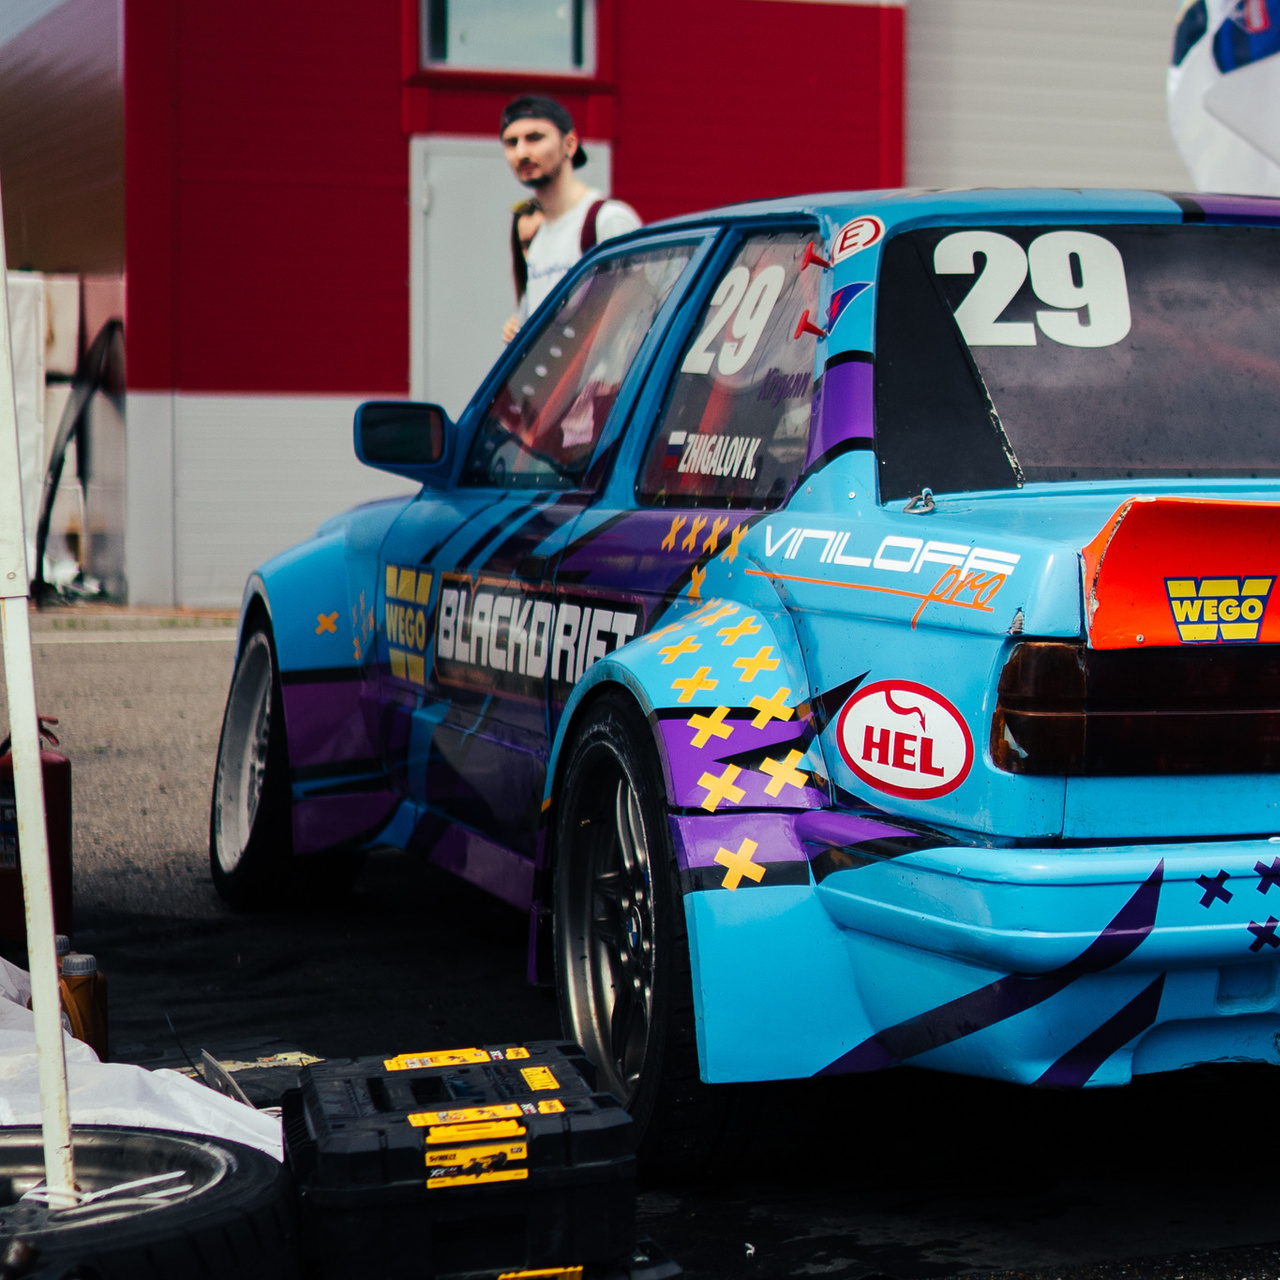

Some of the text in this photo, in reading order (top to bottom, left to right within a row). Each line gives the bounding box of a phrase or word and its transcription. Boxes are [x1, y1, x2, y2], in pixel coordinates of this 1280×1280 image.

[839, 224, 864, 254] E
[934, 231, 1131, 348] 29
[681, 265, 785, 375] 29
[678, 433, 761, 480] ZHIGALOV K.
[385, 602, 426, 651] WEGO
[1171, 598, 1263, 622] WEGO
[438, 588, 637, 684] BLACKDRIFT
[861, 725, 944, 777] HEL
